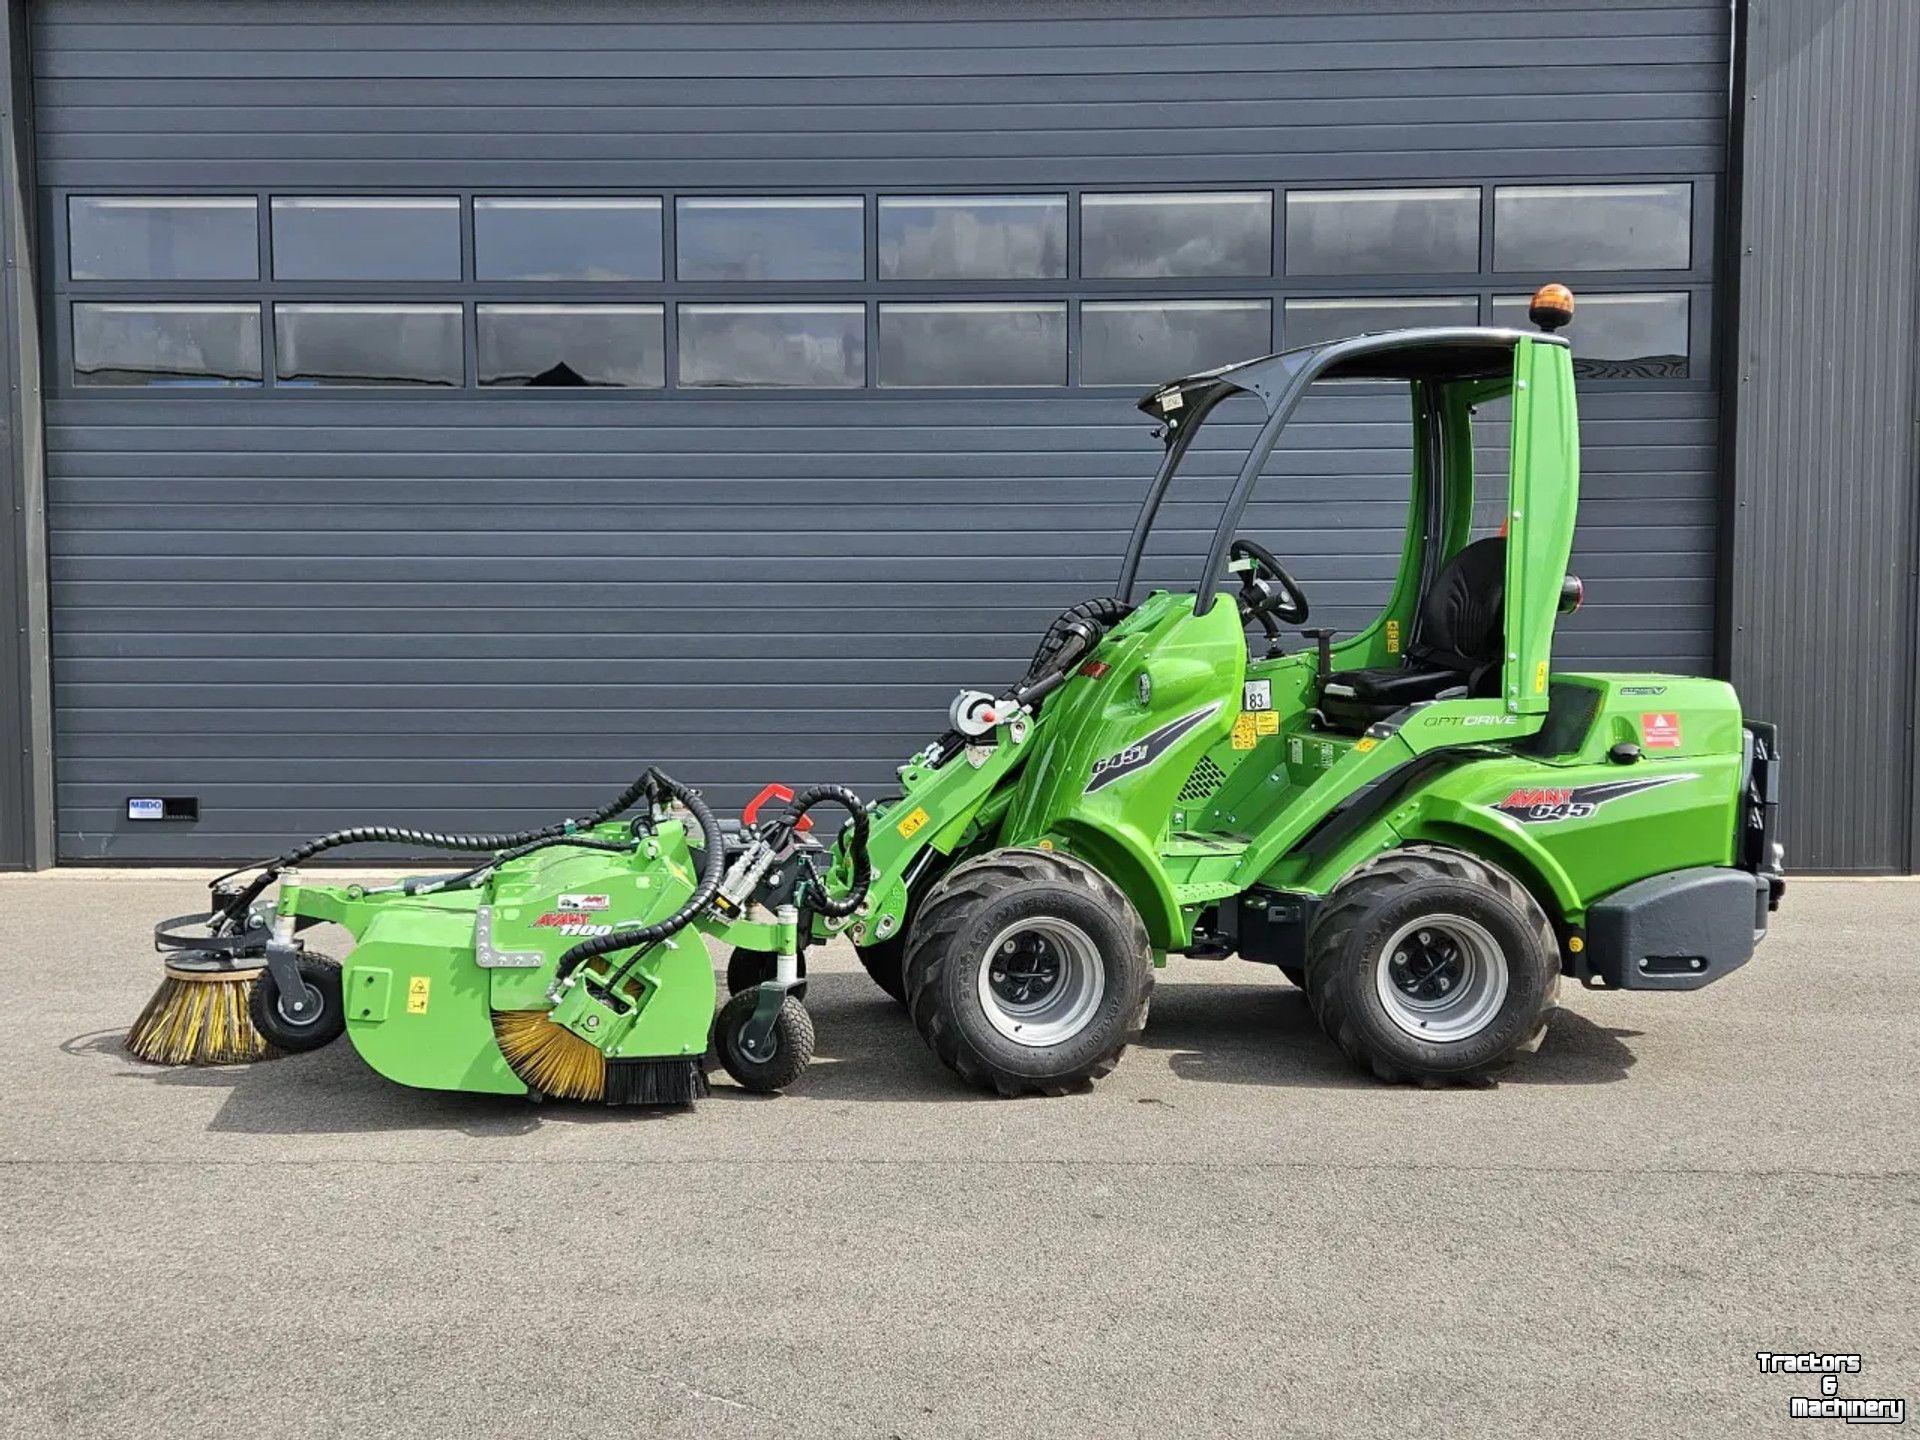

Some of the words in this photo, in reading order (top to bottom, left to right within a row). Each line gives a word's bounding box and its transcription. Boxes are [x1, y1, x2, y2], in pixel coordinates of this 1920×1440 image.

[1249, 693, 1264, 709] 83
[1424, 714, 1518, 727] OPTIDRIVE
[1501, 787, 1574, 809] AVANT
[533, 912, 591, 927] AVANT
[559, 924, 614, 936] 1100
